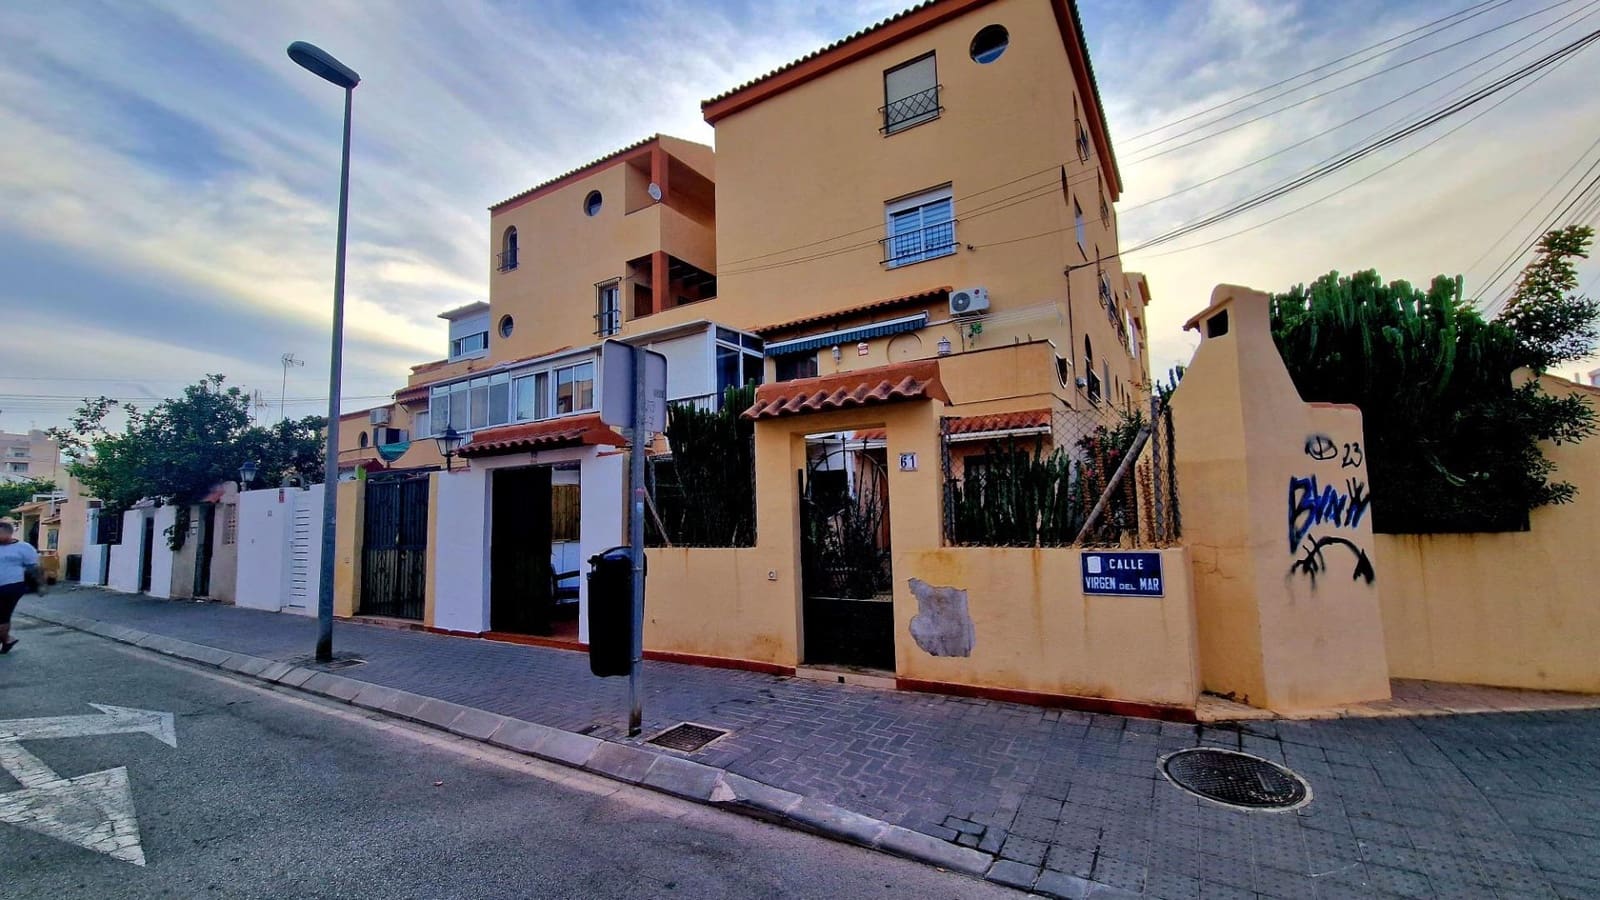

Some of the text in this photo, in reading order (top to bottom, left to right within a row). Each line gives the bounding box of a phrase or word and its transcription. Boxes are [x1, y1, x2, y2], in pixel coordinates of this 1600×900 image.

[901, 455, 914, 468] 61
[1109, 558, 1143, 570] CALLE
[1085, 576, 1116, 590] VIRGEN
[1139, 577, 1159, 591] MAR
